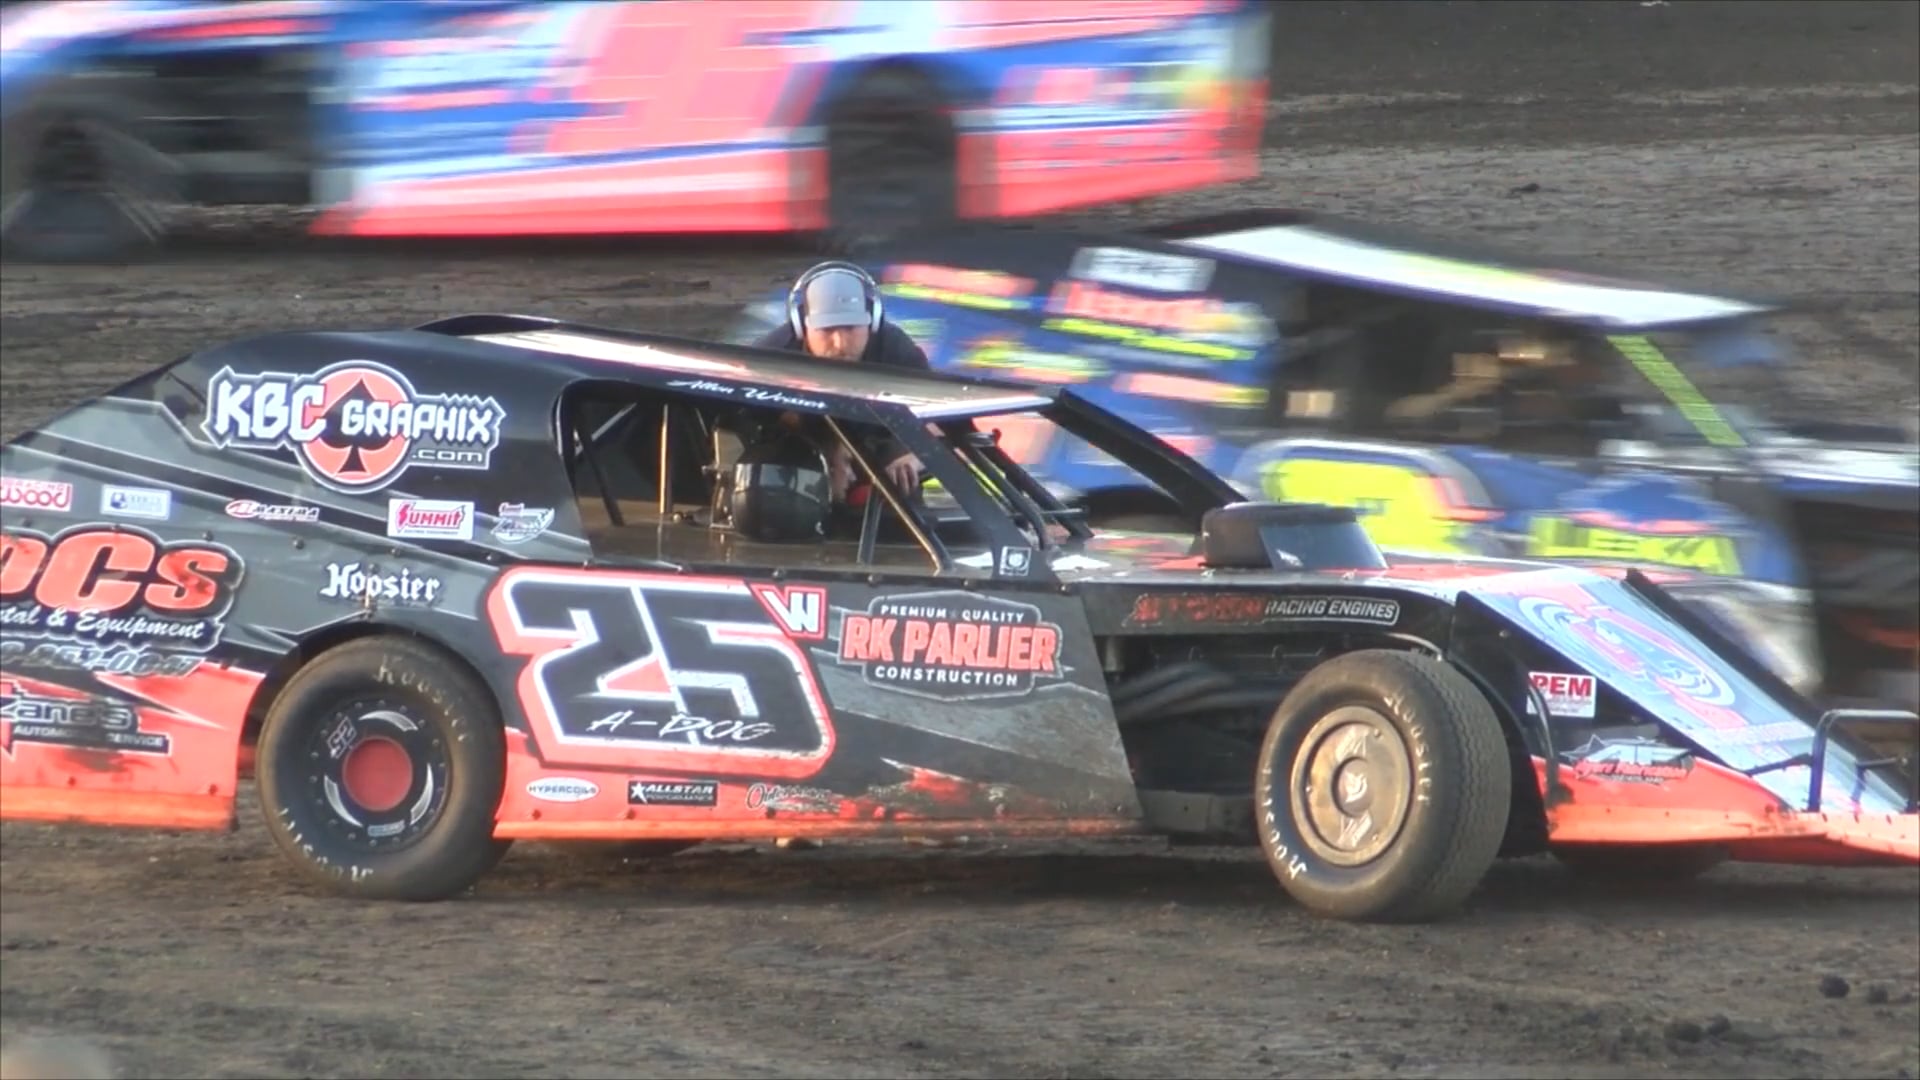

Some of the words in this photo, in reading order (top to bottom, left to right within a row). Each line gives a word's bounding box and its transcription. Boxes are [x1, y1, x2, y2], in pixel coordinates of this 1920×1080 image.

[214, 379, 327, 442] KBC
[340, 399, 493, 444] GRAPHIX
[412, 449, 483, 462] .com
[320, 563, 441, 601] Hoosier
[880, 605, 947, 619] PREMIUM
[961, 609, 1024, 623] QUALITY
[1265, 600, 1325, 616] RACING
[1328, 600, 1395, 619] ENGINES
[0, 606, 41, 625] tal
[47, 610, 68, 627] &
[75, 609, 205, 640] Equipment
[844, 616, 897, 662] RK
[903, 621, 1056, 671] PARLIER
[500, 576, 826, 762] 25
[875, 665, 1018, 687] CONSTRUCTION
[1532, 675, 1592, 697] PEM
[645, 784, 714, 794] ALLSTAR
